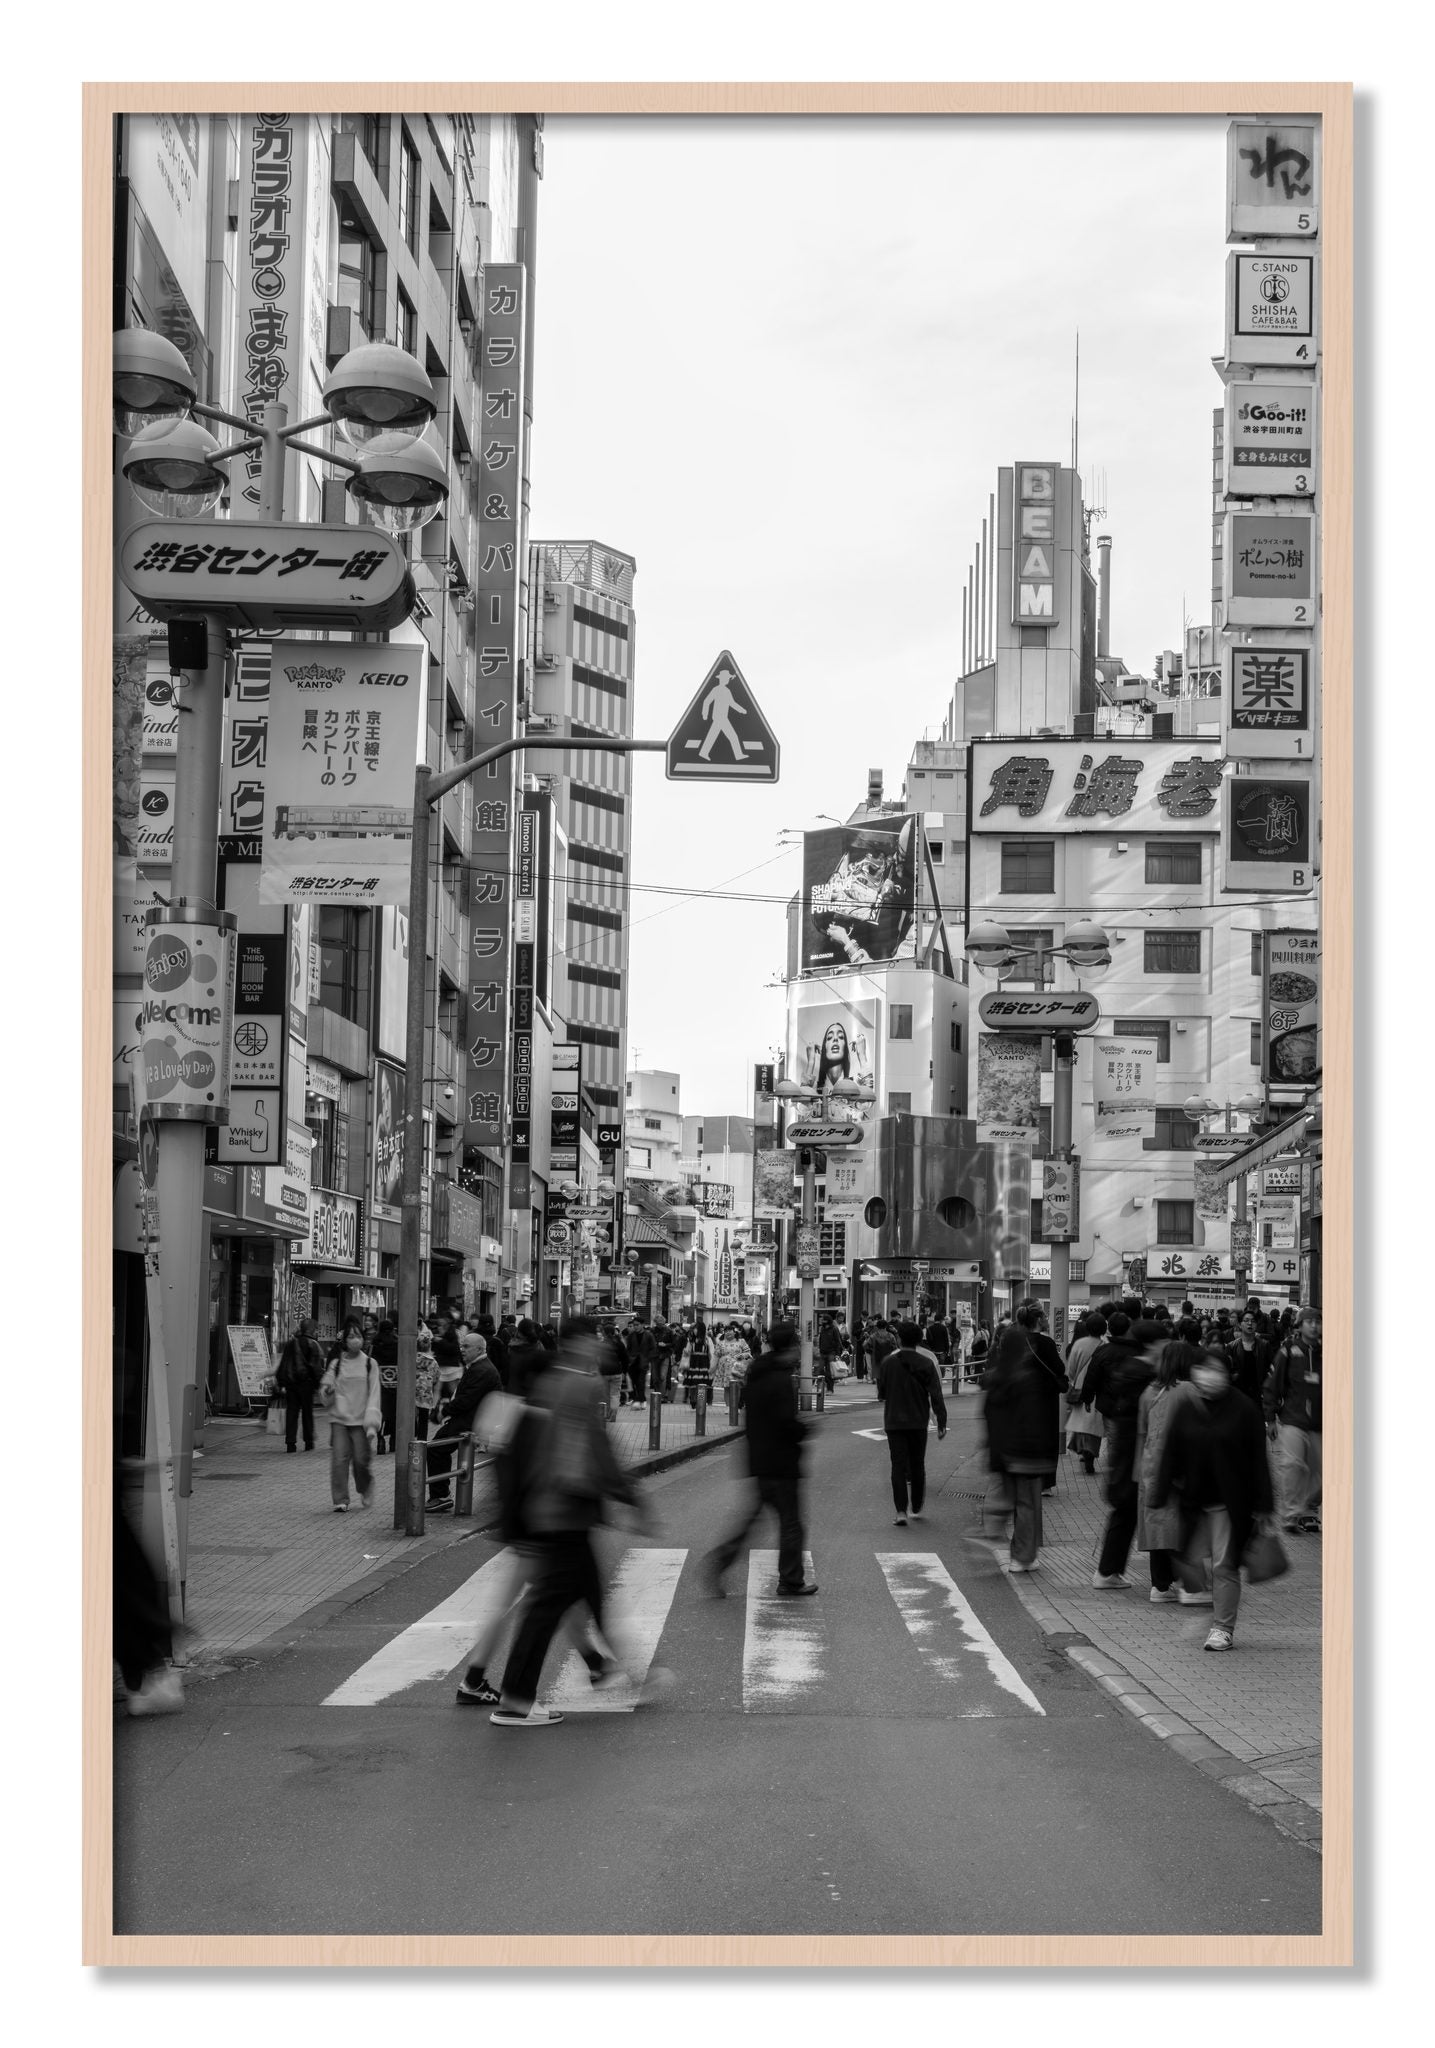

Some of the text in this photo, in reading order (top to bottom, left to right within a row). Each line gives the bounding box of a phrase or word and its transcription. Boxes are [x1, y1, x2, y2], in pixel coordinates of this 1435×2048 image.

[250, 127, 293, 268] カラオケ
[1298, 214, 1310, 229] 5
[1252, 263, 1298, 273] C.STAND
[1252, 305, 1297, 315] SHISHA
[1252, 316, 1297, 325] CAFE&BAR
[1296, 344, 1308, 360] 4
[1250, 405, 1306, 421] Goo-it!
[1243, 426, 1303, 434] 渋谷宇田川町店
[1238, 452, 1308, 463] 全身もみほぐし
[1295, 475, 1307, 491] 3
[1021, 468, 1054, 616] BEAM
[133, 542, 389, 580] 渋谷センター街
[1295, 606, 1306, 621] 2
[297, 681, 333, 689] KANTO
[359, 673, 408, 687] KEIO
[1242, 656, 1294, 708] 薬
[1236, 711, 1300, 726] マツモトキヨシ
[302, 709, 319, 753] 冒険へ
[321, 710, 339, 785] カントーの
[342, 710, 360, 786] ポケパーク
[364, 711, 381, 771] 京王線で
[1294, 738, 1302, 753] 1
[980, 755, 1224, 817] 角海老
[1237, 795, 1299, 845] 一蘭
[521, 816, 532, 893] kimono hearts
[289, 877, 380, 890] 渋谷センター街
[1293, 870, 1304, 886] B
[246, 947, 261, 955] THE
[147, 949, 188, 984] Enjoy
[143, 1000, 222, 1026] Welcome
[986, 1001, 1092, 1015] 渋谷センター街
[1270, 1011, 1299, 1031] 6F
[160, 1060, 192, 1080] Lovely
[193, 1060, 213, 1076] Day!
[230, 1127, 264, 1139] Whisky
[600, 1131, 620, 1142] GU
[229, 1137, 249, 1146] Bank
